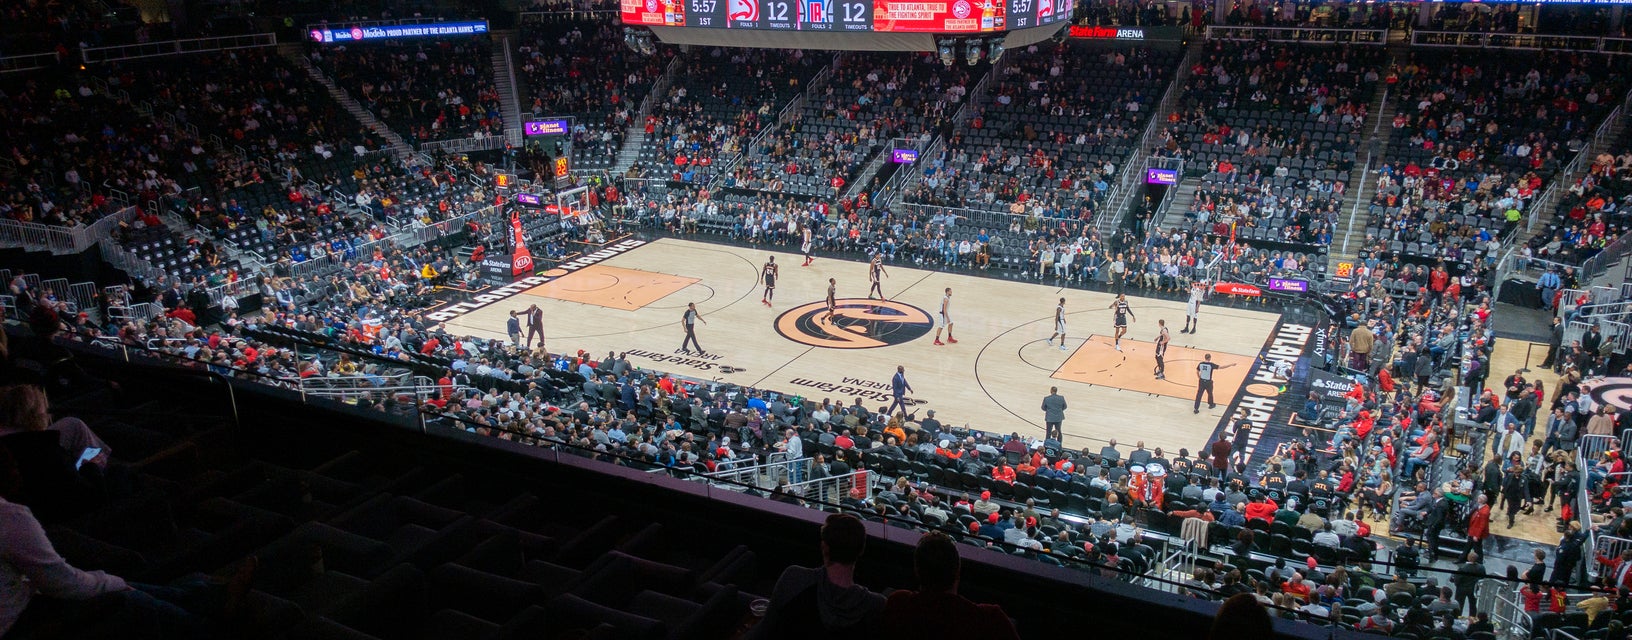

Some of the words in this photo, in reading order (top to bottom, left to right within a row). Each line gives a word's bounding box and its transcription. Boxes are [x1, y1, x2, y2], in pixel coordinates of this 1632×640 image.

[692, 0, 717, 13] 5:57
[767, 2, 788, 20] 12
[842, 3, 866, 21] 12
[1012, 0, 1032, 13] 5:57
[1017, 18, 1027, 26] 1ST
[363, 27, 386, 38] Modelo
[387, 29, 402, 37] PROUD
[402, 27, 422, 36] PARTNER
[422, 27, 430, 35] OF
[439, 26, 457, 34] ATLANTA
[1116, 29, 1144, 38] ARENA
[560, 239, 647, 270] HAWKS
[517, 257, 528, 266] KIA
[426, 275, 550, 322] ATLANTA
[1313, 327, 1327, 357] xfinity
[841, 376, 894, 391] ARENA
[1194, 463, 1208, 471] ATL
[1269, 476, 1283, 484] ATL
[1314, 482, 1328, 491] ATL
